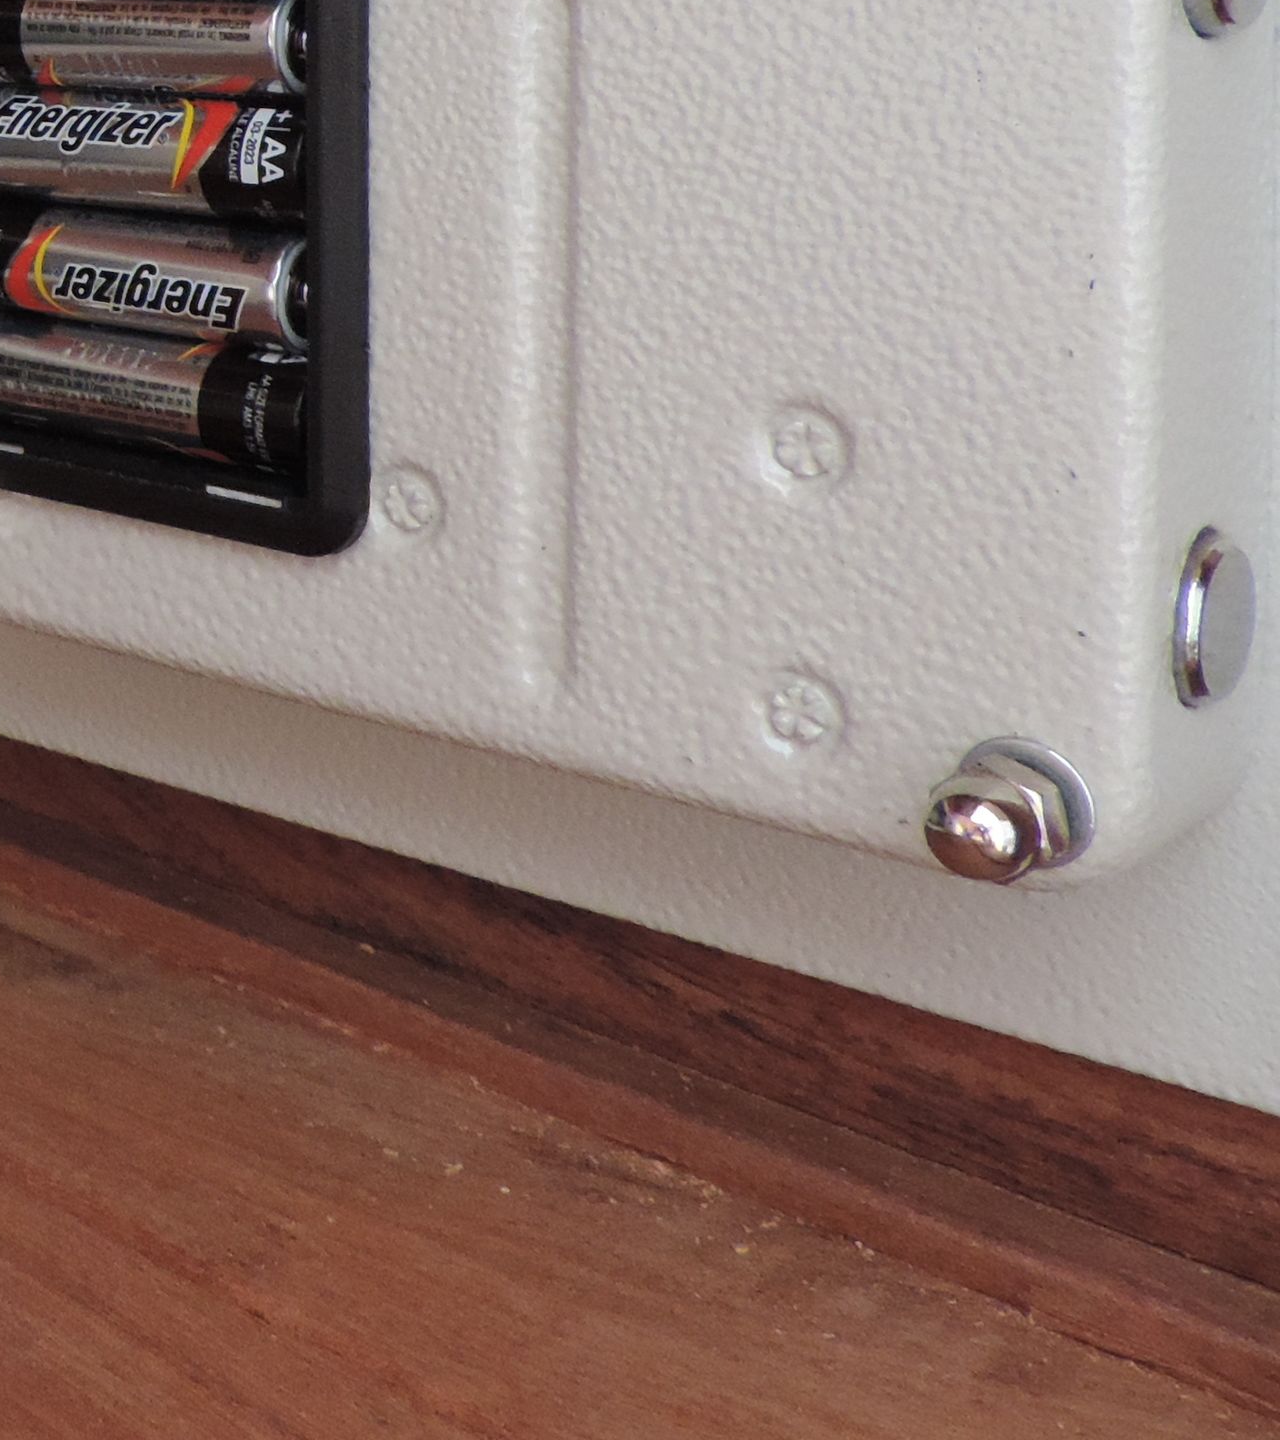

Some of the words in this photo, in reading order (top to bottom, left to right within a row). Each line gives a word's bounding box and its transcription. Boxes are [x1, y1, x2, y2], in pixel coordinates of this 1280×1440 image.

[244, 120, 263, 165] 03-2023
[261, 136, 287, 184] AA
[54, 264, 249, 332] Energizer
